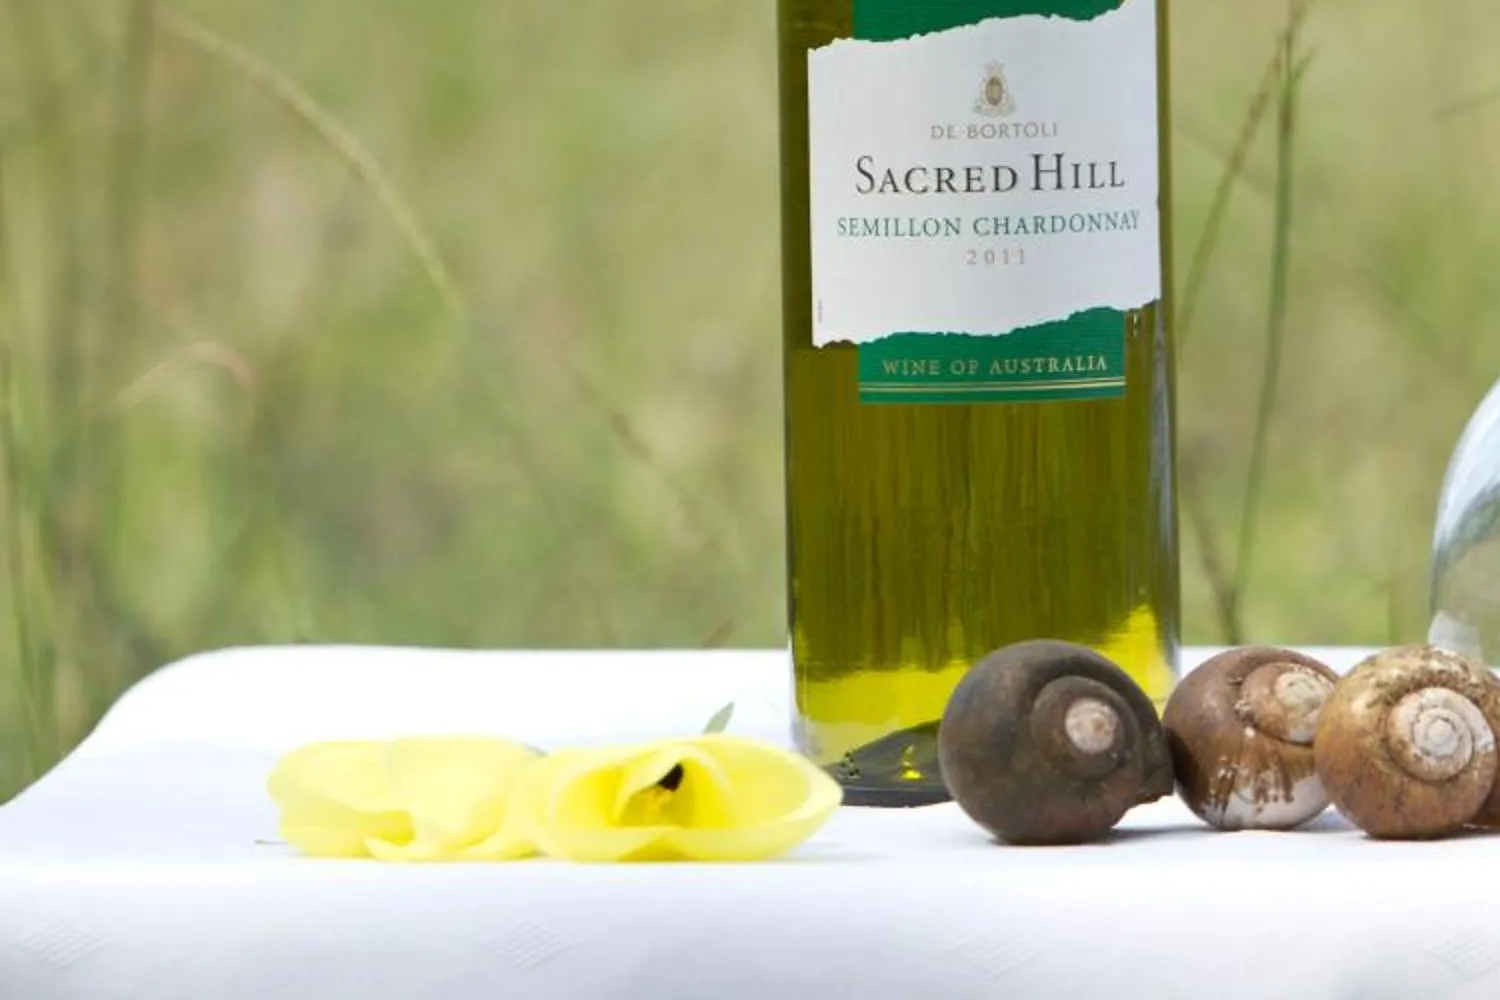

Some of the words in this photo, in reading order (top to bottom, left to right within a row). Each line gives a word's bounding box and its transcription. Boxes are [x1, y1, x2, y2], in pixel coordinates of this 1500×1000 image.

[931, 123, 956, 140] DE
[967, 122, 1058, 139] BORTOLI
[855, 154, 1018, 195] SACRED
[1031, 152, 1126, 191] HILL
[837, 216, 961, 238] SEMILLON
[972, 209, 1141, 236] CHARDONNAY
[966, 248, 1026, 266] 2011
[882, 358, 940, 376] WINE
[951, 359, 979, 375] OF
[989, 355, 1108, 375] AUSTRALIA
